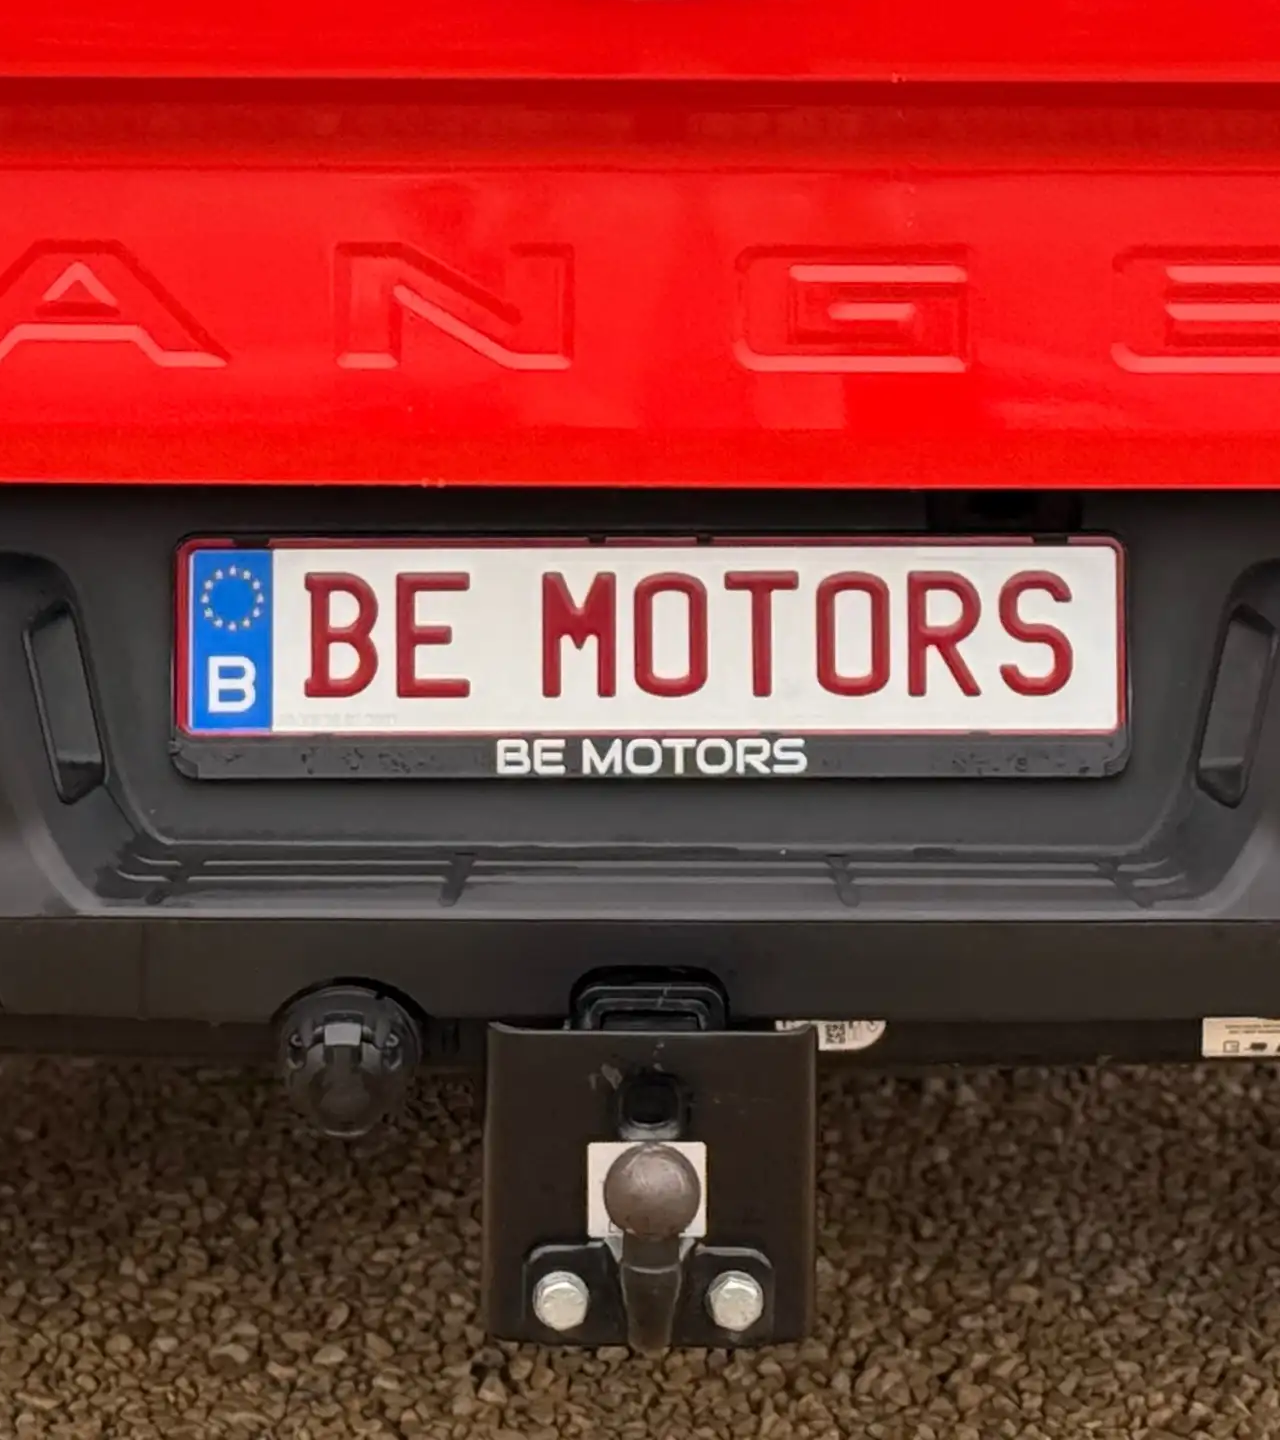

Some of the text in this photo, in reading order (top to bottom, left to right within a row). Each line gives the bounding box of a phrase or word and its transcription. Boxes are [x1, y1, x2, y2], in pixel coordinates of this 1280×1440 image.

[303, 570, 1074, 699] BE MOTORS
[206, 656, 257, 714] B
[496, 738, 809, 776] BE MOTORS
